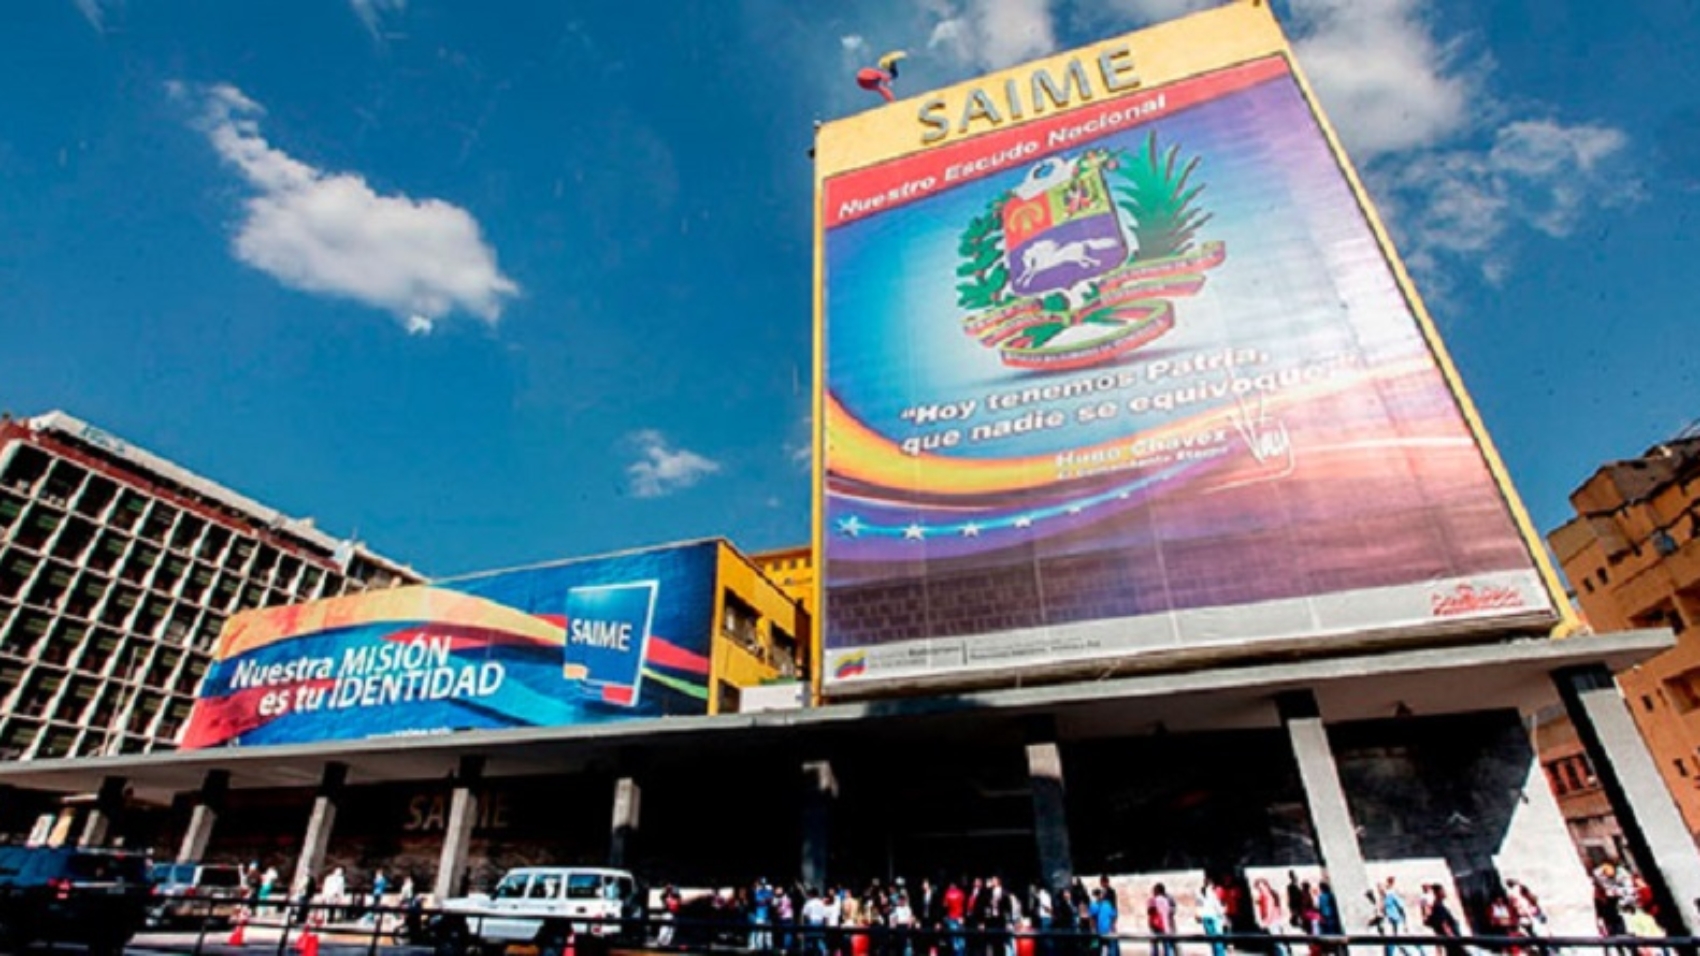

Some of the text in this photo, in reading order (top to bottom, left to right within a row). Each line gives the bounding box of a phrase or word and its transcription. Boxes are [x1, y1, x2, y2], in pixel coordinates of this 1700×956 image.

[918, 47, 1141, 145] SAIME
[838, 95, 1167, 219] Nuestro Escudo Nacional
[989, 373, 1136, 410] tenemos
[1146, 347, 1269, 380] Patria,
[902, 429, 961, 456] que
[972, 409, 1065, 441] nadie
[1079, 401, 1118, 423] se
[229, 633, 451, 689] Nuestra MISIÓN
[571, 617, 632, 652] SAIME
[259, 663, 505, 715] es tu IDENTIDAD
